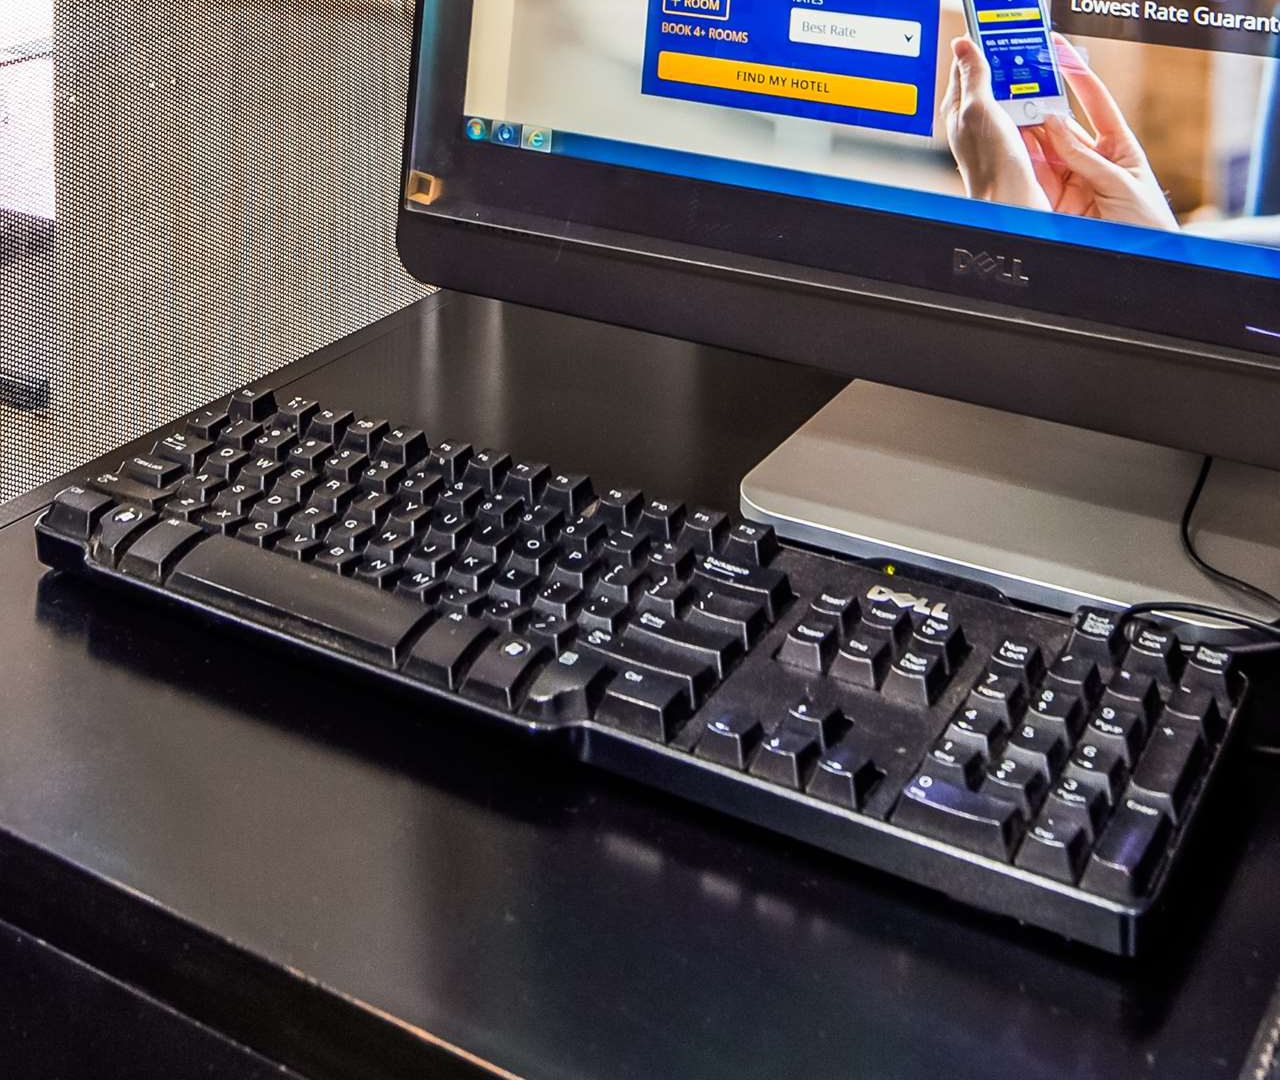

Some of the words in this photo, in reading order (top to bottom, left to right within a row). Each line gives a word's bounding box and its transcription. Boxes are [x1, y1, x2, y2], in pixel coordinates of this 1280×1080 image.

[1144, 1, 1188, 24] Rate
[661, 22, 692, 37] BOOK
[693, 25, 706, 37] 4+
[708, 28, 749, 44] ROOMS
[801, 20, 827, 35] Best
[830, 24, 857, 39] Rate
[736, 70, 765, 84] FIND
[769, 74, 787, 87] MY
[791, 78, 830, 93] HOTEL
[291, 469, 306, 479] E
[569, 551, 582, 559] P
[866, 585, 949, 621] DELL
[1101, 706, 1115, 720] 9
[1083, 745, 1097, 758] 6
[919, 775, 933, 787] 0
[1063, 778, 1078, 791] 3
